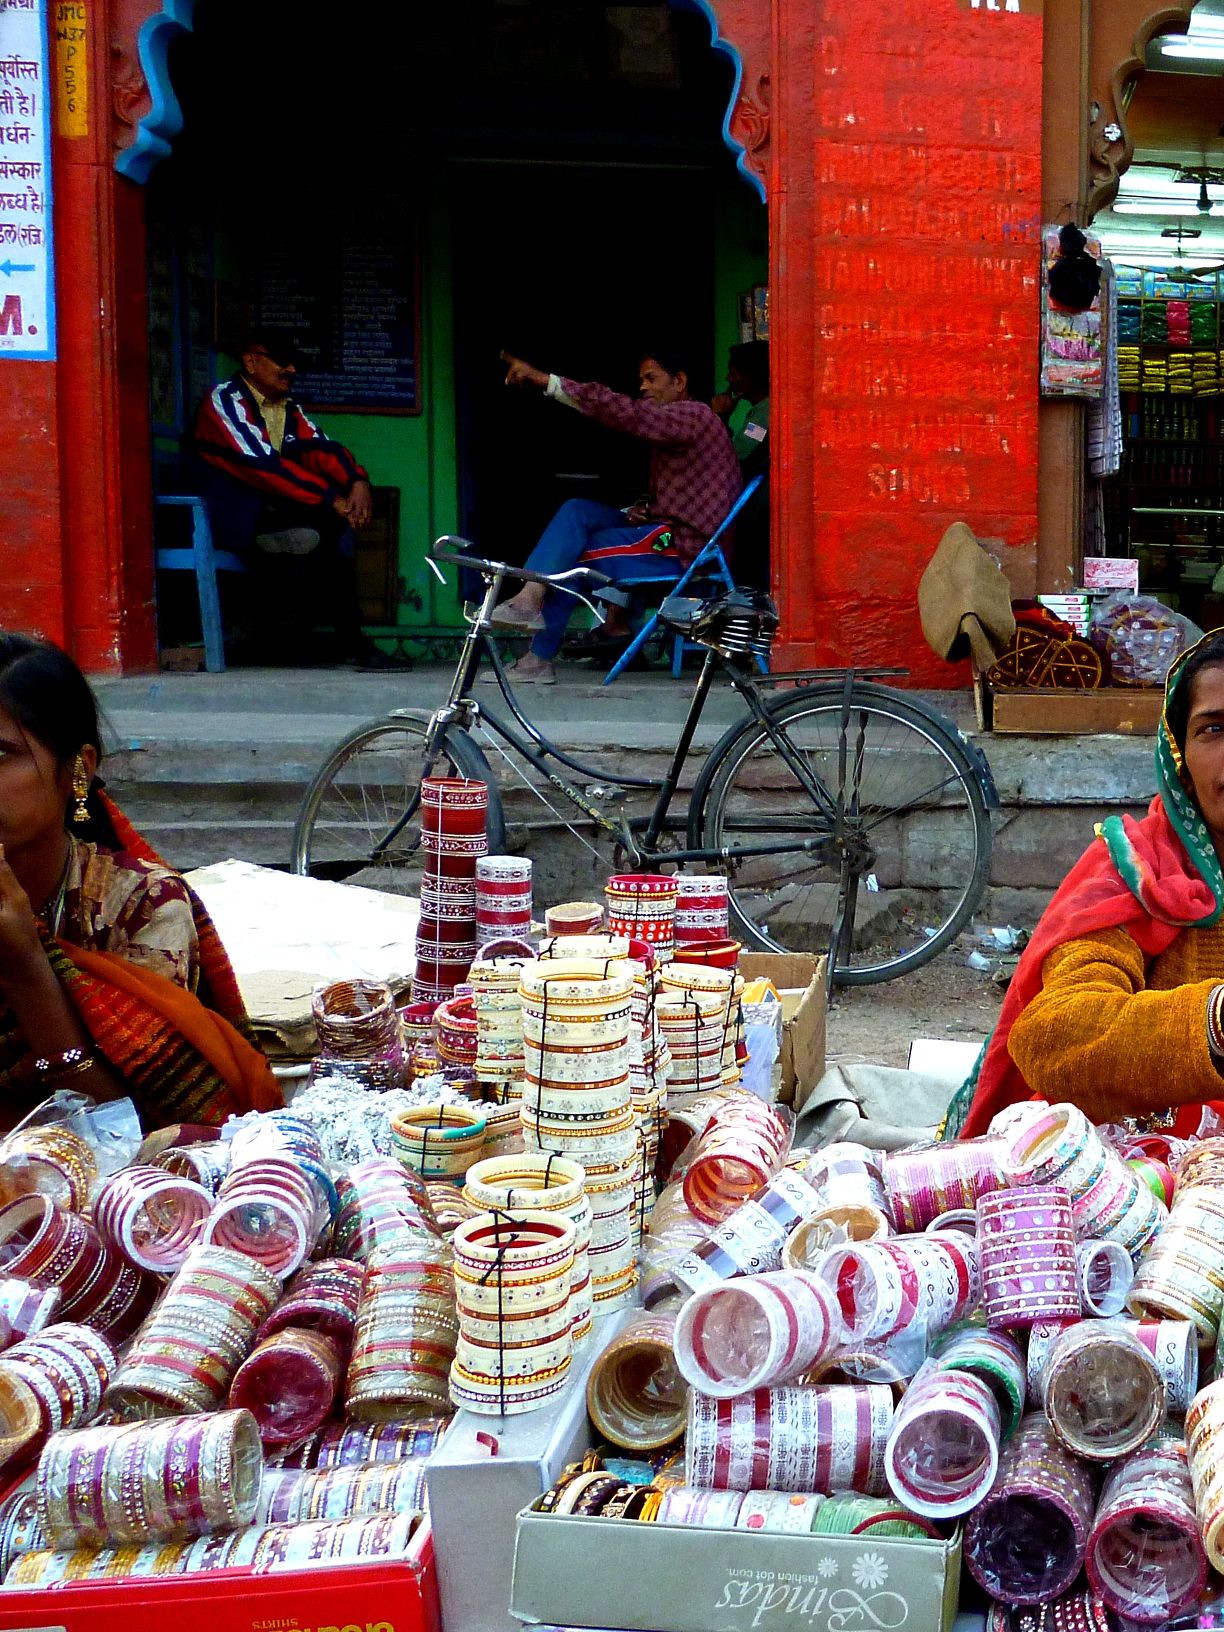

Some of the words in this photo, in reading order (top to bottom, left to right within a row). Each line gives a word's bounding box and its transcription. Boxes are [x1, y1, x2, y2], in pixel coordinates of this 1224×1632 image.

[57, 5, 86, 21] JMC
[756, 1569, 775, 1580] dot
[777, 1571, 819, 1584] fashion
[714, 1579, 909, 1632] Bindas
[251, 1617, 299, 1630] SHIRTS
